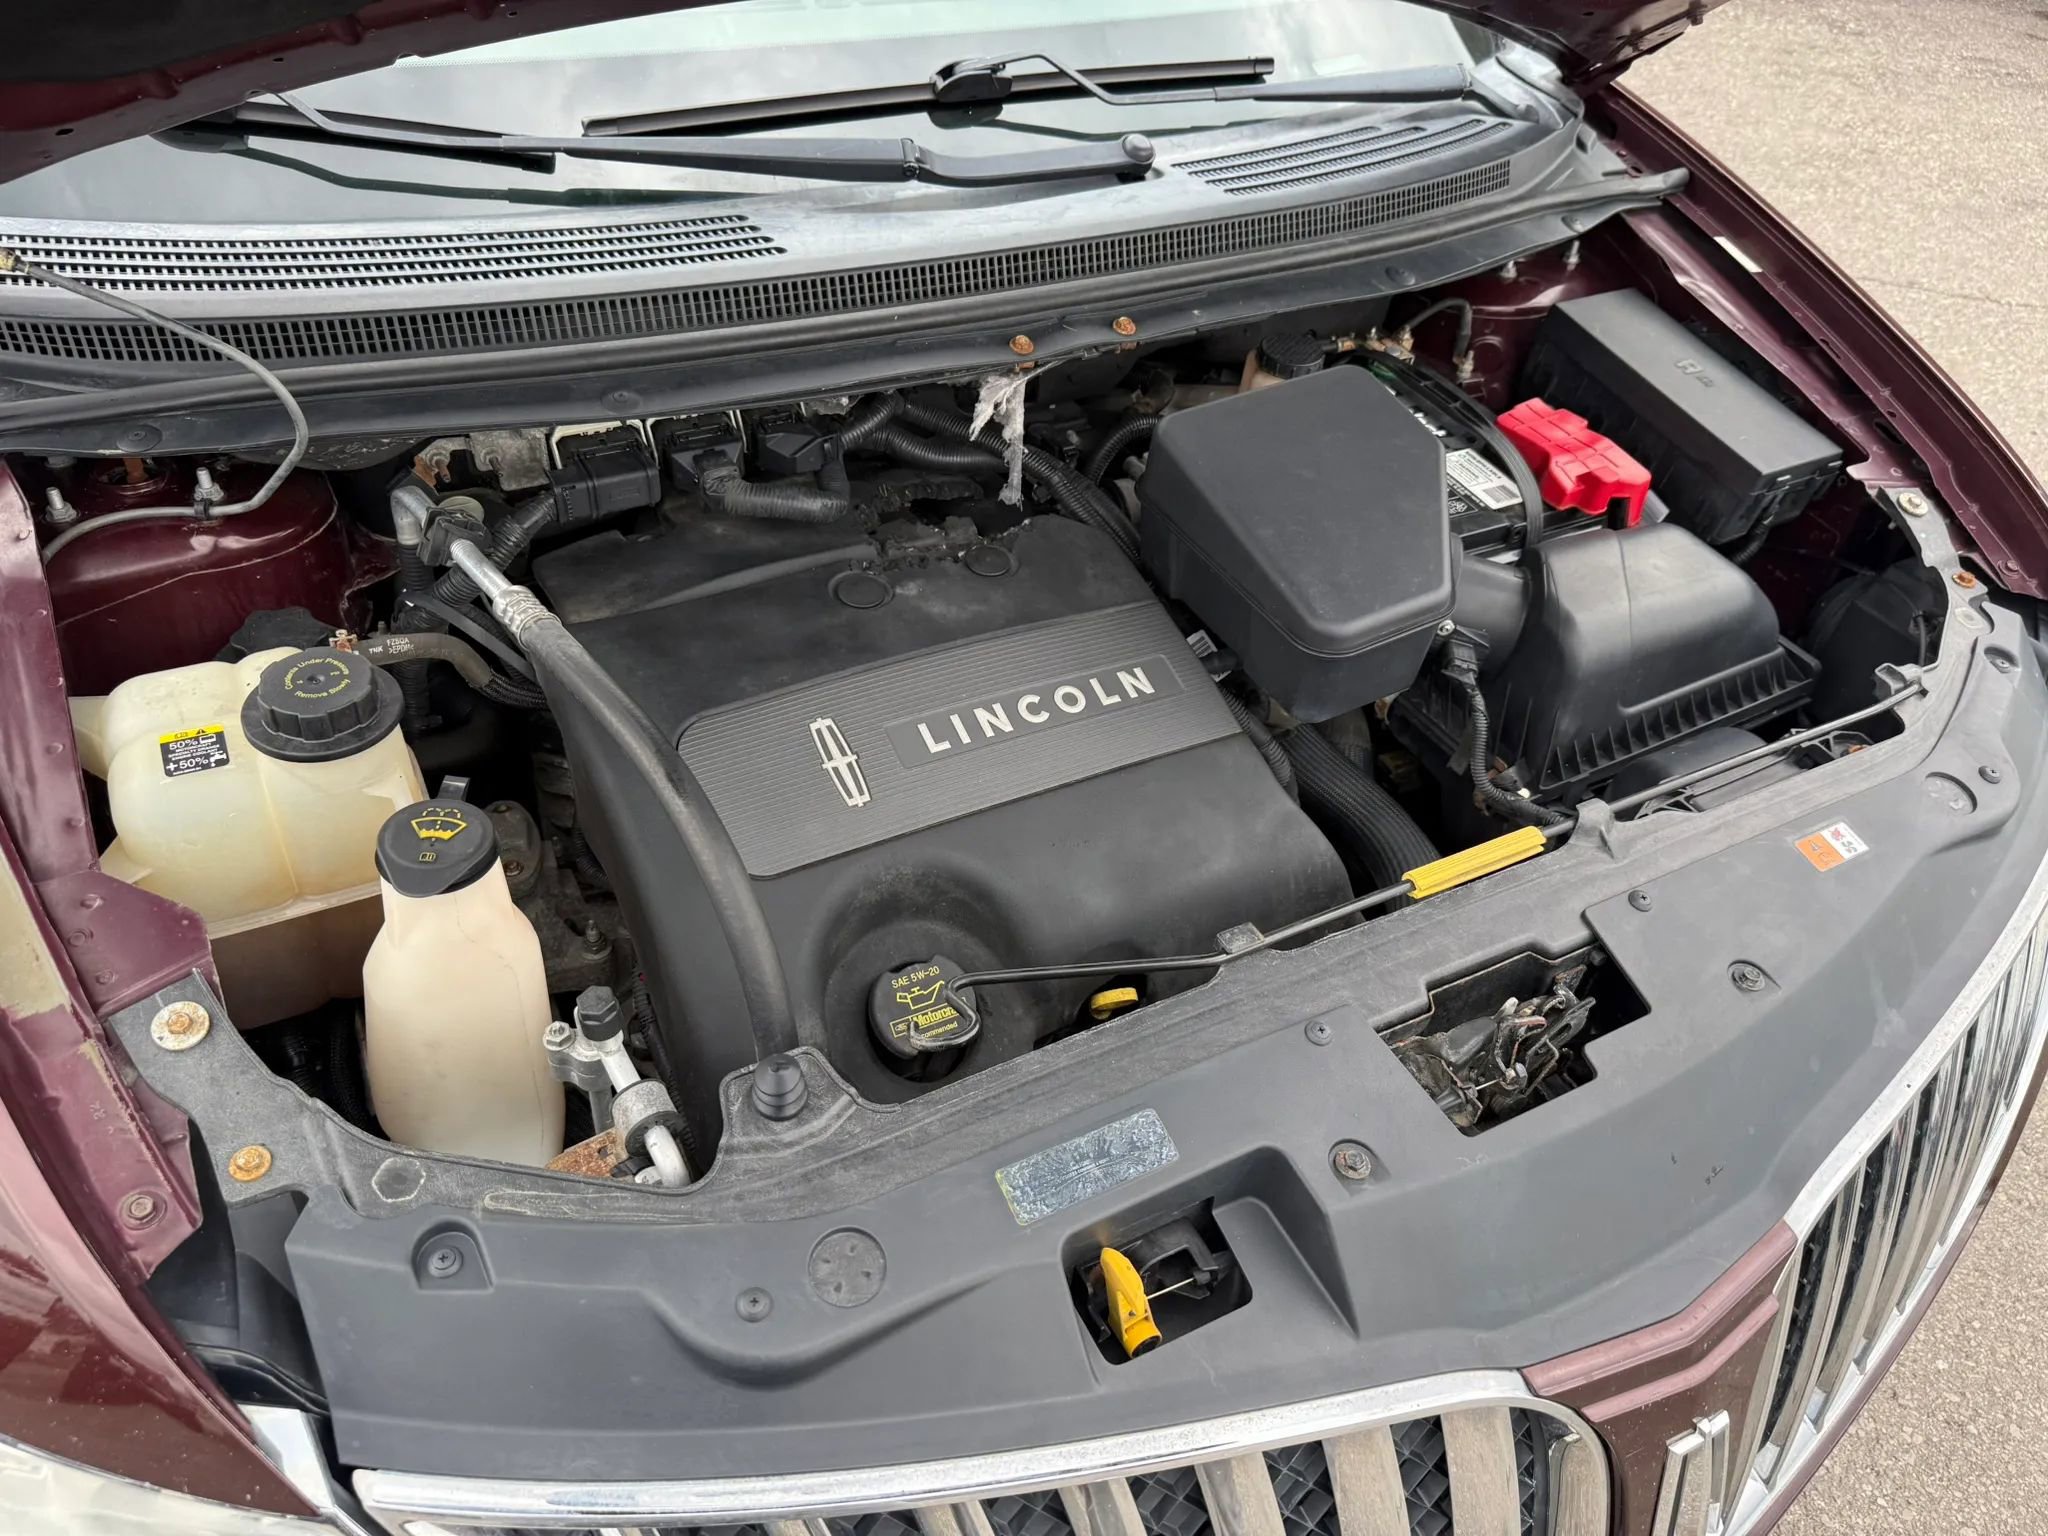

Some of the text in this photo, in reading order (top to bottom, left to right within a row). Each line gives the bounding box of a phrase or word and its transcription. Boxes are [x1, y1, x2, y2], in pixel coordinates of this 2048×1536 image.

[297, 657, 324, 669] Under
[294, 690, 328, 699] Remove
[917, 666, 1155, 754] LINCOLN
[169, 738, 198, 751] 50%
[891, 965, 940, 989] SAE 5W-20
[913, 1006, 957, 1027] Motorcra
